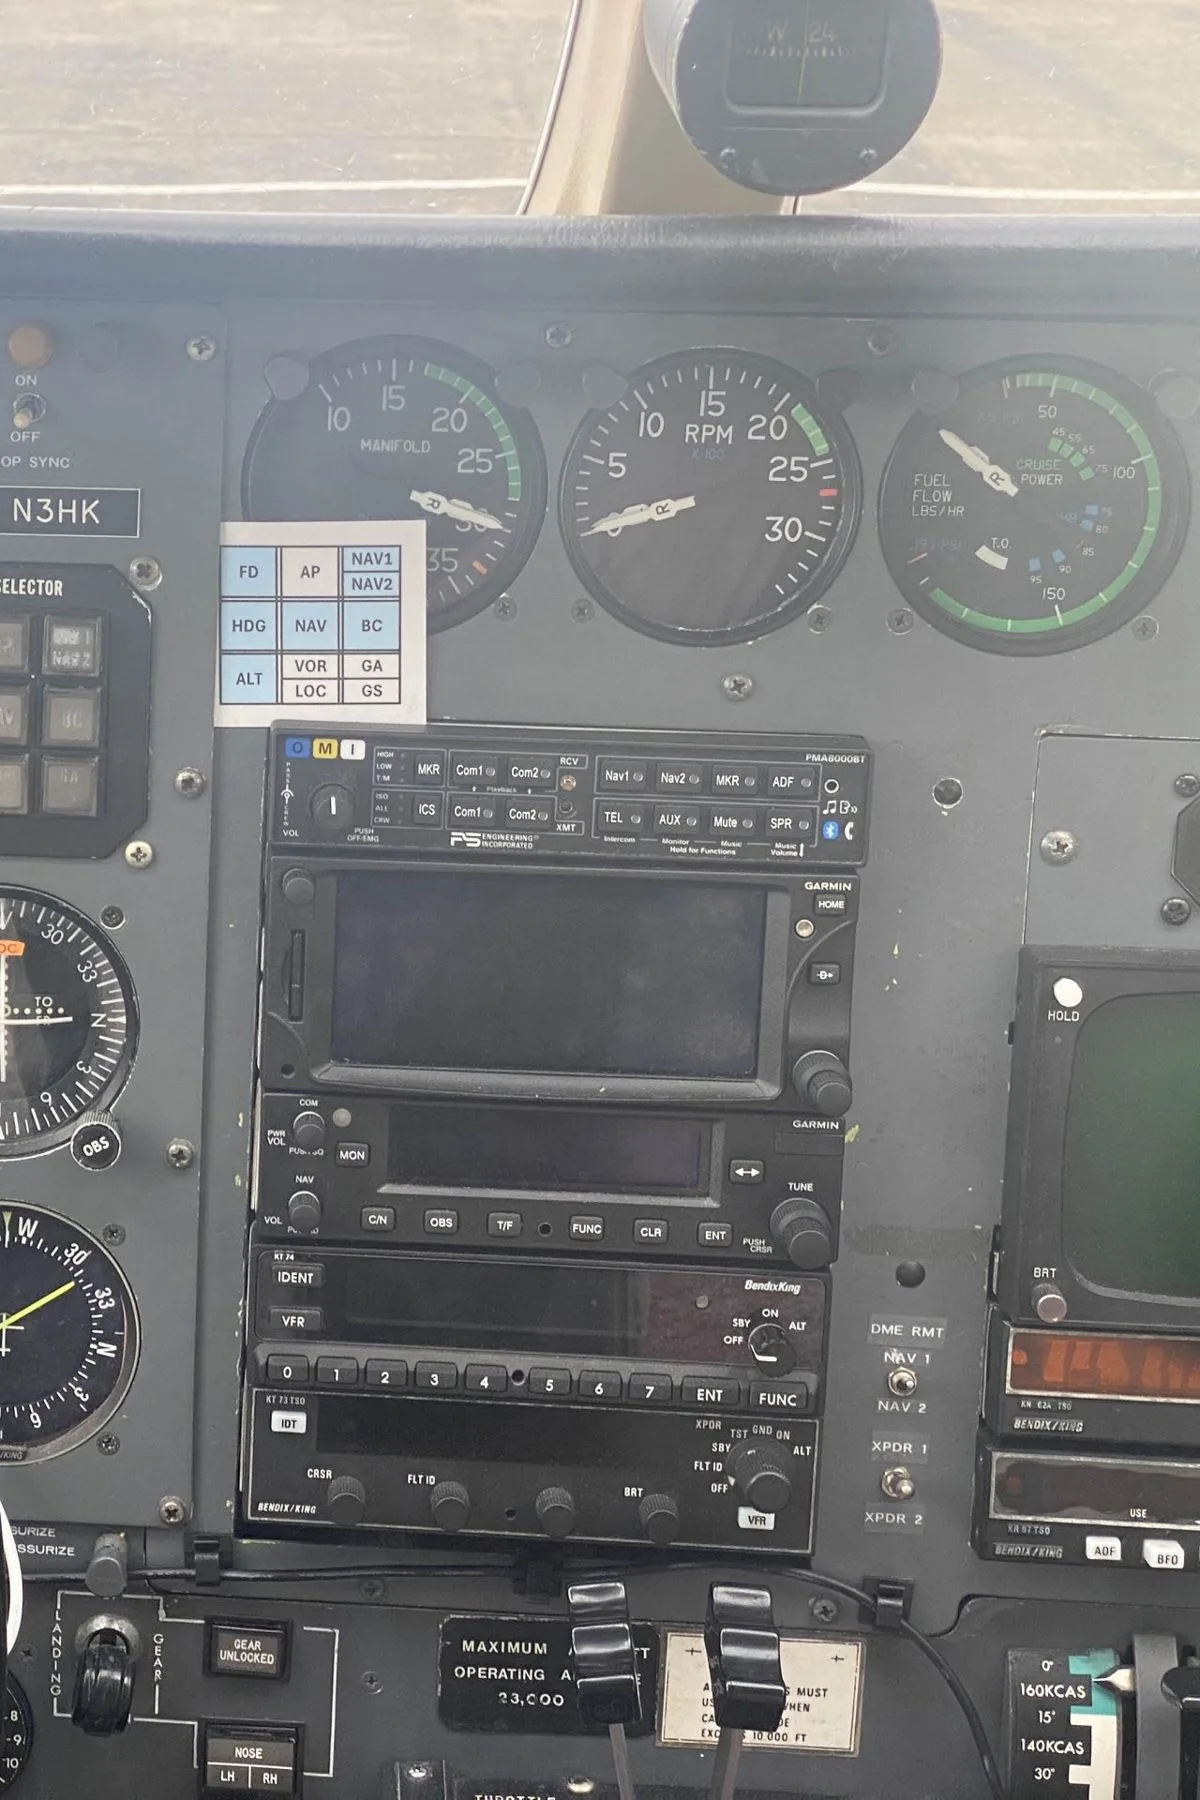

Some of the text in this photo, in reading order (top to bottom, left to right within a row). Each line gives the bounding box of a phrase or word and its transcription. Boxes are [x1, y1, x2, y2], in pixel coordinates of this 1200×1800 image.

[15, 374, 37, 386] ON
[382, 385, 405, 410] 15
[700, 391, 726, 417] 15
[1038, 405, 1057, 418] 50
[327, 406, 350, 431] 10
[432, 408, 467, 433] 20
[639, 412, 664, 437] 10
[748, 415, 788, 440] 20
[10, 431, 40, 442] OFF
[685, 425, 732, 444] RPM
[360, 439, 430, 453] MANIFOLD
[29, 457, 70, 468] SYNC
[457, 449, 493, 473] 25
[1017, 460, 1061, 470] CRUISE
[769, 456, 808, 482] 25
[1113, 466, 1135, 479] 100
[914, 474, 951, 487] FUEL
[1021, 474, 1063, 485] POWER
[913, 490, 952, 502] FLOW
[13, 498, 100, 524] N3HK
[912, 506, 964, 516] LBS/HR
[765, 517, 802, 542] 30
[352, 552, 392, 565] NAV1
[240, 565, 258, 578] FD
[301, 566, 320, 578] AP
[352, 578, 392, 591] NAV2
[1042, 588, 1065, 600] 150
[232, 619, 266, 632] HDG
[295, 620, 326, 632] NAV
[362, 620, 382, 632] BC
[295, 660, 327, 672] VOR
[362, 660, 383, 672] GA
[236, 673, 262, 685] ALT
[296, 685, 326, 697] LOC
[362, 685, 382, 697] GS
[319, 743, 332, 754] M
[418, 764, 440, 776] MKR
[456, 764, 538, 778] Com1 Com2
[605, 770, 685, 784] Nav1 Nav2
[716, 774, 740, 786] MKR
[772, 776, 794, 788] ADF
[419, 804, 435, 816] ICS
[454, 806, 536, 820] Com1 Com2
[604, 812, 680, 825] TEL AUX
[714, 816, 737, 828] Mute
[770, 818, 792, 829] SPR
[804, 882, 851, 891] GARMIN
[818, 900, 844, 909] HOME
[35, 997, 52, 1007] TO
[1048, 1010, 1079, 1022] HOLD
[793, 1120, 839, 1130] GARMIN
[82, 1137, 110, 1156] OBS
[268, 1137, 286, 1146] VOL
[340, 1151, 364, 1160] MON
[788, 1182, 813, 1192] TUNE
[368, 1214, 388, 1225] C/N
[430, 1218, 452, 1228] OBS
[497, 1221, 512, 1230] T/F
[19, 1217, 39, 1237] W
[573, 1224, 602, 1234] FUNC
[640, 1228, 662, 1238] CLR
[706, 1230, 726, 1240] ENT
[278, 1272, 313, 1284] IDENT
[1034, 1267, 1056, 1278] BRT
[762, 1308, 778, 1318] ON
[282, 1316, 304, 1328] VFR
[732, 1318, 750, 1328] SBY
[871, 1323, 944, 1338] DME RMT
[697, 1389, 723, 1402] ENT
[759, 1393, 796, 1406] FUNC
[878, 1401, 926, 1413] NAV 2
[282, 1419, 297, 1429] IDT
[696, 1420, 721, 1430] XPDR
[752, 1425, 772, 1435] GND
[731, 1429, 748, 1438] TST
[712, 1443, 731, 1452] SBY
[793, 1446, 812, 1456] ALT
[694, 1461, 722, 1472] FLT ID
[307, 1468, 332, 1479] CRSR
[408, 1474, 436, 1485] FLT ID
[624, 1487, 644, 1498] BRT
[711, 1484, 728, 1493] OFF
[258, 1502, 316, 1514] BENDIX/KING
[1130, 1508, 1147, 1518] USE
[748, 1516, 766, 1526] VFR
[864, 1512, 922, 1525] XPDR 2
[1158, 1554, 1177, 1565] BFO
[234, 1639, 261, 1651] GEAR
[462, 1640, 547, 1655] MAXIMUM
[220, 1650, 274, 1665] UNLOCKED
[454, 1666, 545, 1681] OPERATING
[797, 1687, 828, 1698] MUST
[1020, 1683, 1086, 1698] 160KCAS
[1021, 1739, 1084, 1754] 140KCAS
[235, 1747, 262, 1759] NOSE
[220, 1770, 235, 1781] LH
[263, 1773, 278, 1785] RH
